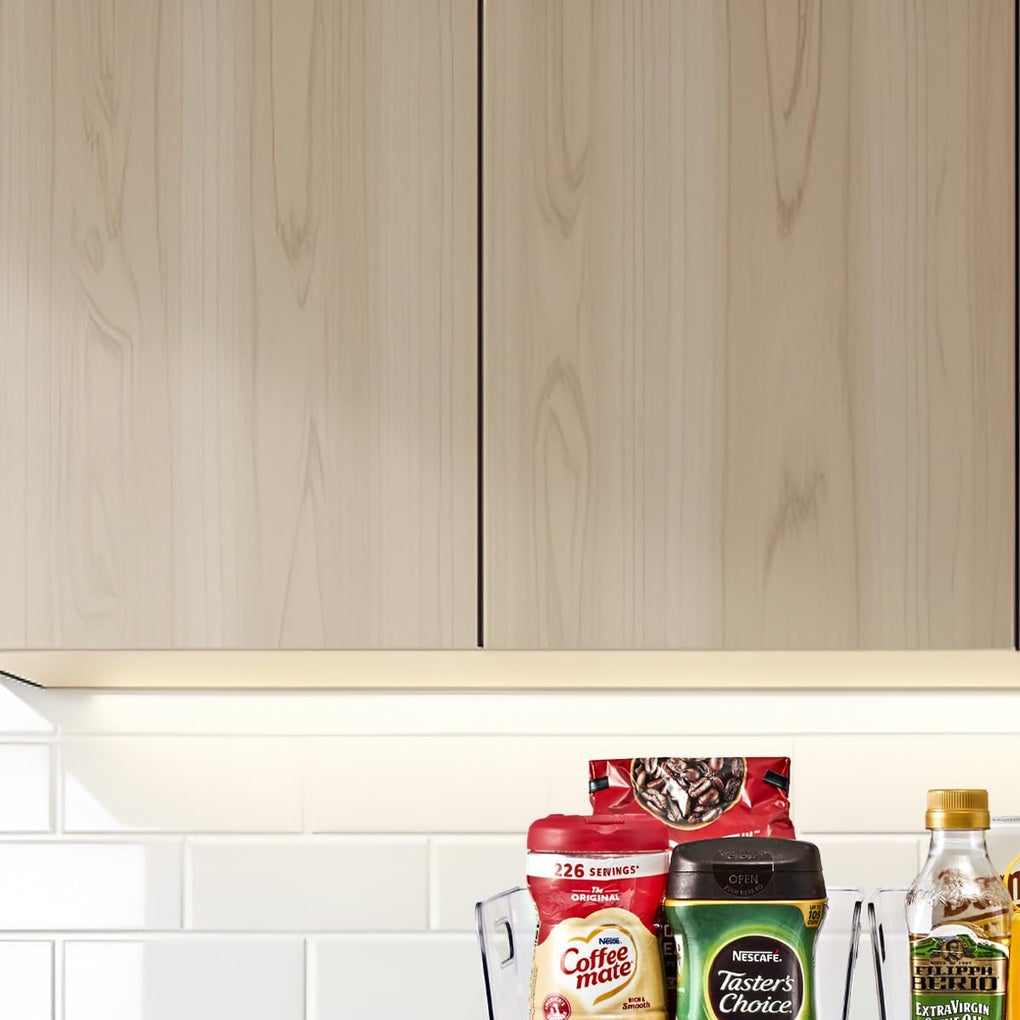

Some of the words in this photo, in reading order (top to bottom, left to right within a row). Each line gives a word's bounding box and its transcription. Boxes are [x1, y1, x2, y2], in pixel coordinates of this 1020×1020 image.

[554, 863, 584, 878] 226
[728, 874, 759, 885] OPEN
[571, 893, 620, 902] ORIGINAL
[591, 886, 604, 894] The
[560, 946, 629, 976] Coffee
[576, 961, 633, 990] mate
[717, 969, 795, 992] Taster's
[912, 976, 997, 991] BERIO
[622, 1001, 651, 1011] Smooth
[719, 993, 792, 1014] Choice
[916, 1002, 952, 1016] EXTRA
[950, 1000, 990, 1016] VIRGIN
